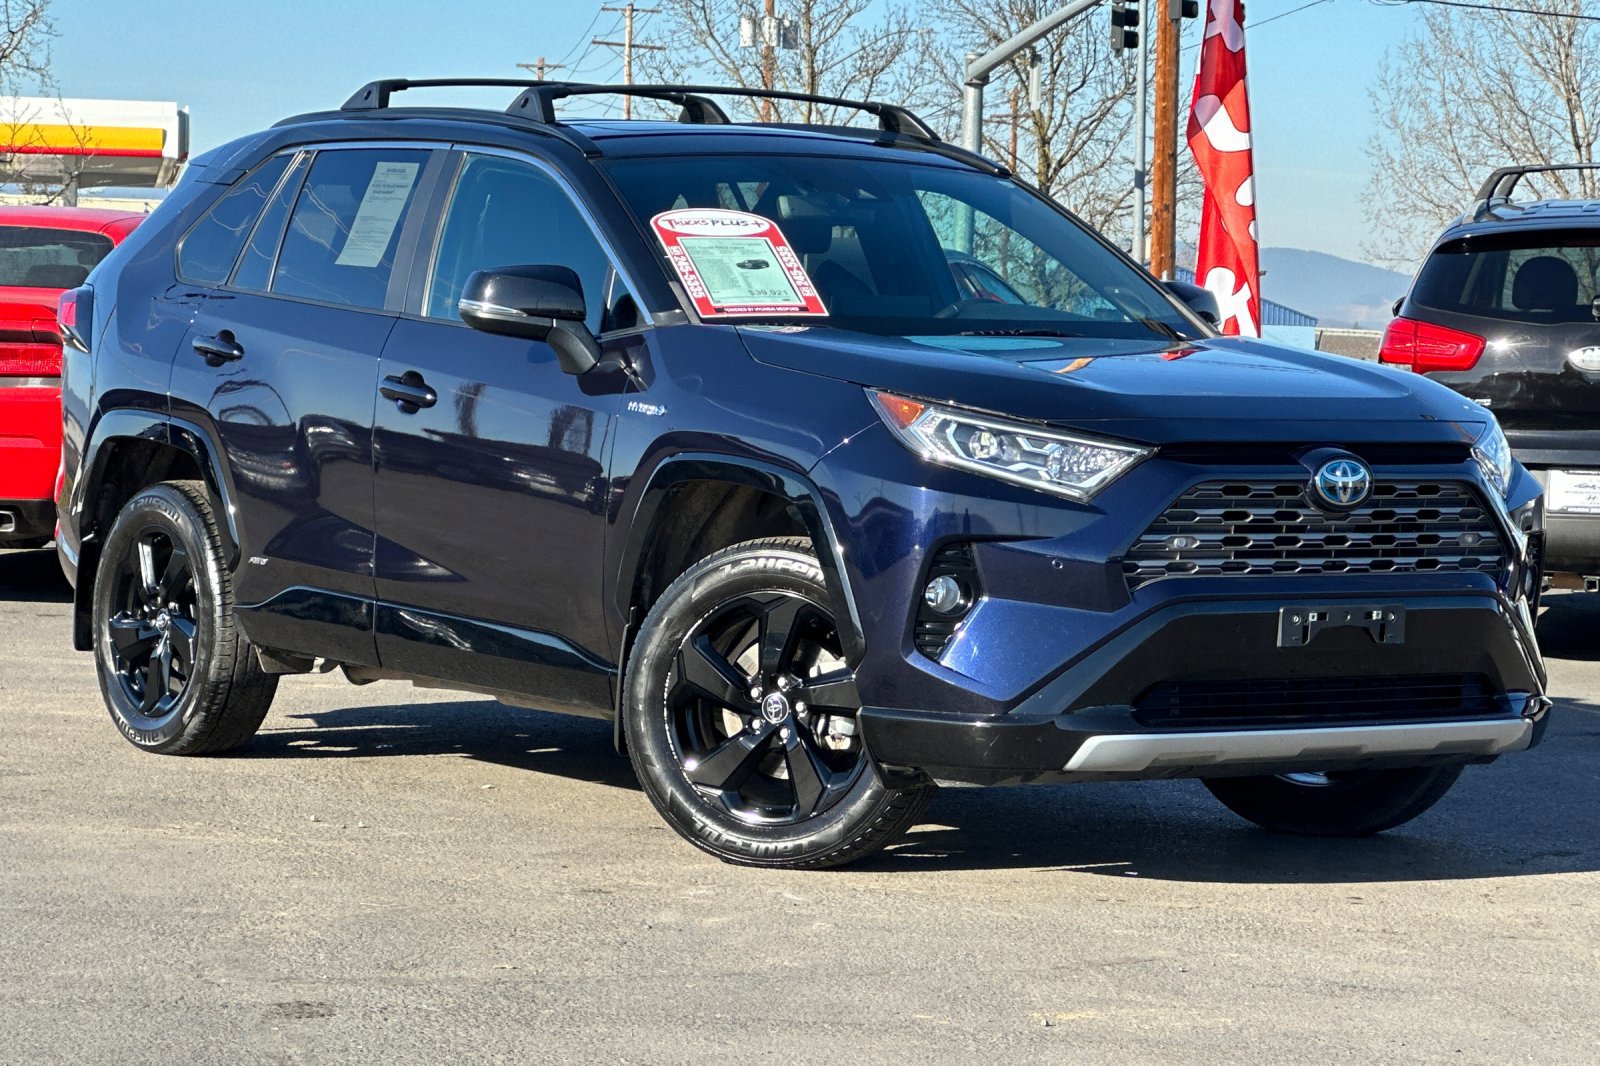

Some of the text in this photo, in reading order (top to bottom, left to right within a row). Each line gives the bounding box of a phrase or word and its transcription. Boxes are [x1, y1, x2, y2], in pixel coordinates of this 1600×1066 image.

[661, 218, 709, 229] TRUCKS
[674, 255, 707, 298] 245-5335
[775, 246, 810, 287] 245-5335
